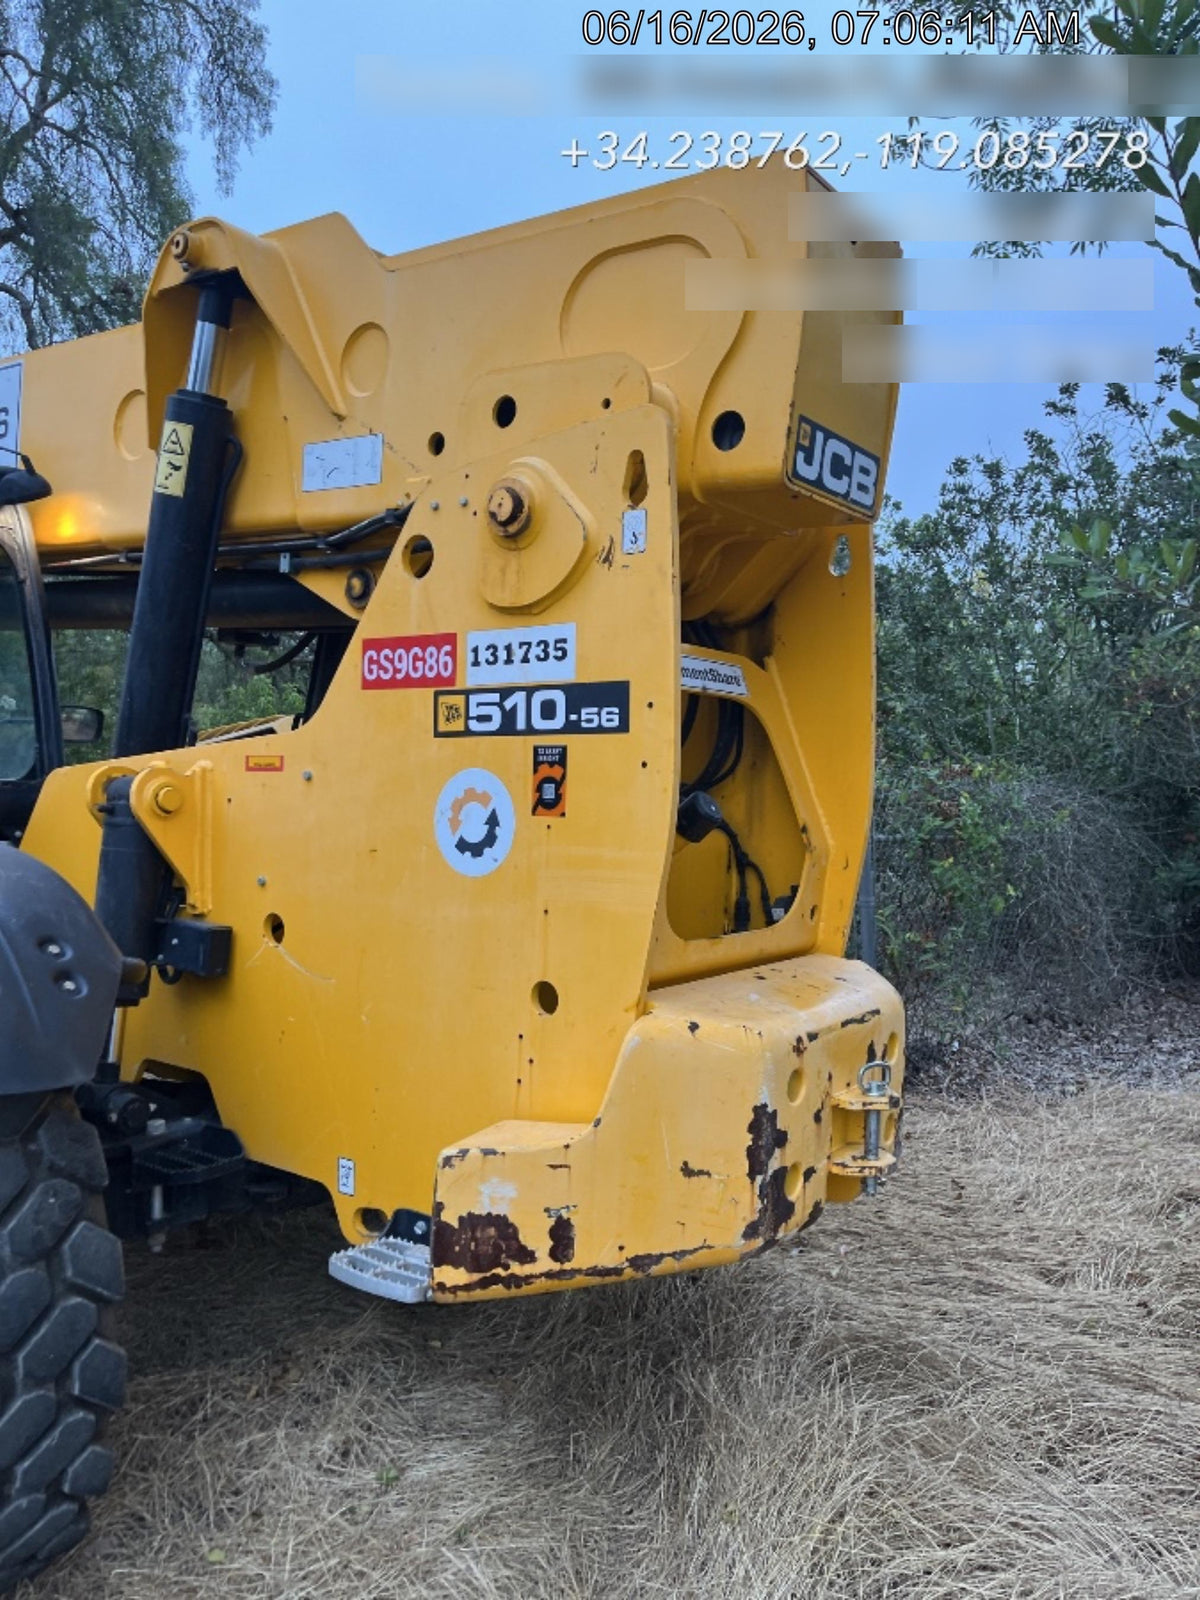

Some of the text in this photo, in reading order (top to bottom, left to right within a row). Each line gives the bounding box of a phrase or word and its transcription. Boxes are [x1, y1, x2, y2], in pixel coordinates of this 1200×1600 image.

[796, 430, 877, 506] JCB
[363, 645, 453, 680] GS9G86
[470, 638, 568, 667] 131735
[467, 689, 620, 732] 510-56
